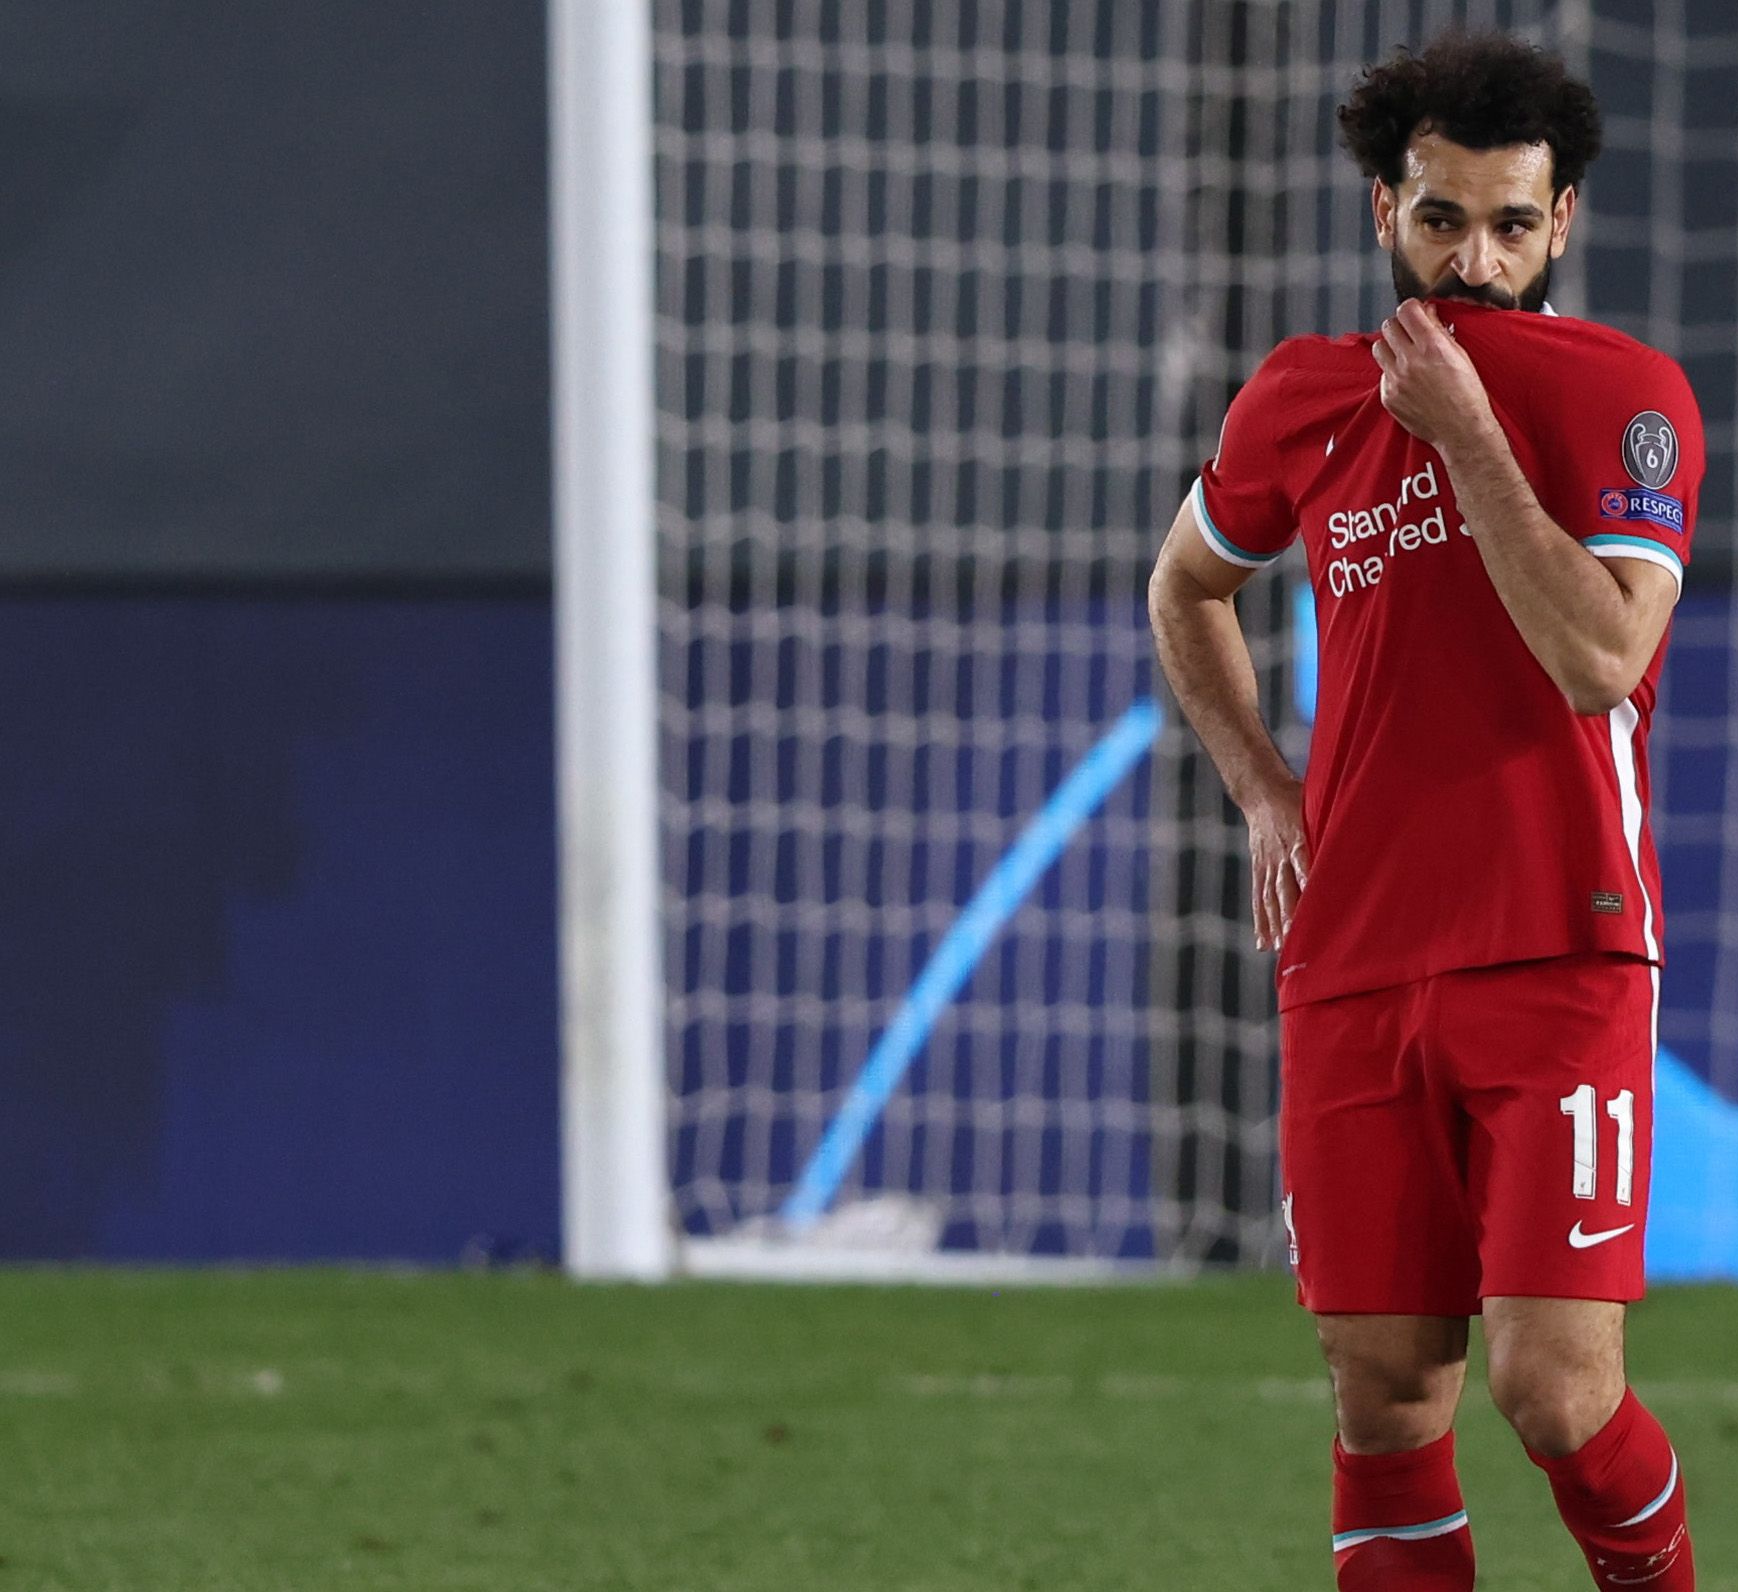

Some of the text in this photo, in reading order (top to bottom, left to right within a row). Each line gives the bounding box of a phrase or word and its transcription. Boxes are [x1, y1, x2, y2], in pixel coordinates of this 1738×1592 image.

[1646, 448, 1658, 468] 6
[1328, 461, 1439, 549] Stanrd
[1328, 507, 1448, 598] Chared
[1560, 1084, 1635, 1206] 11
